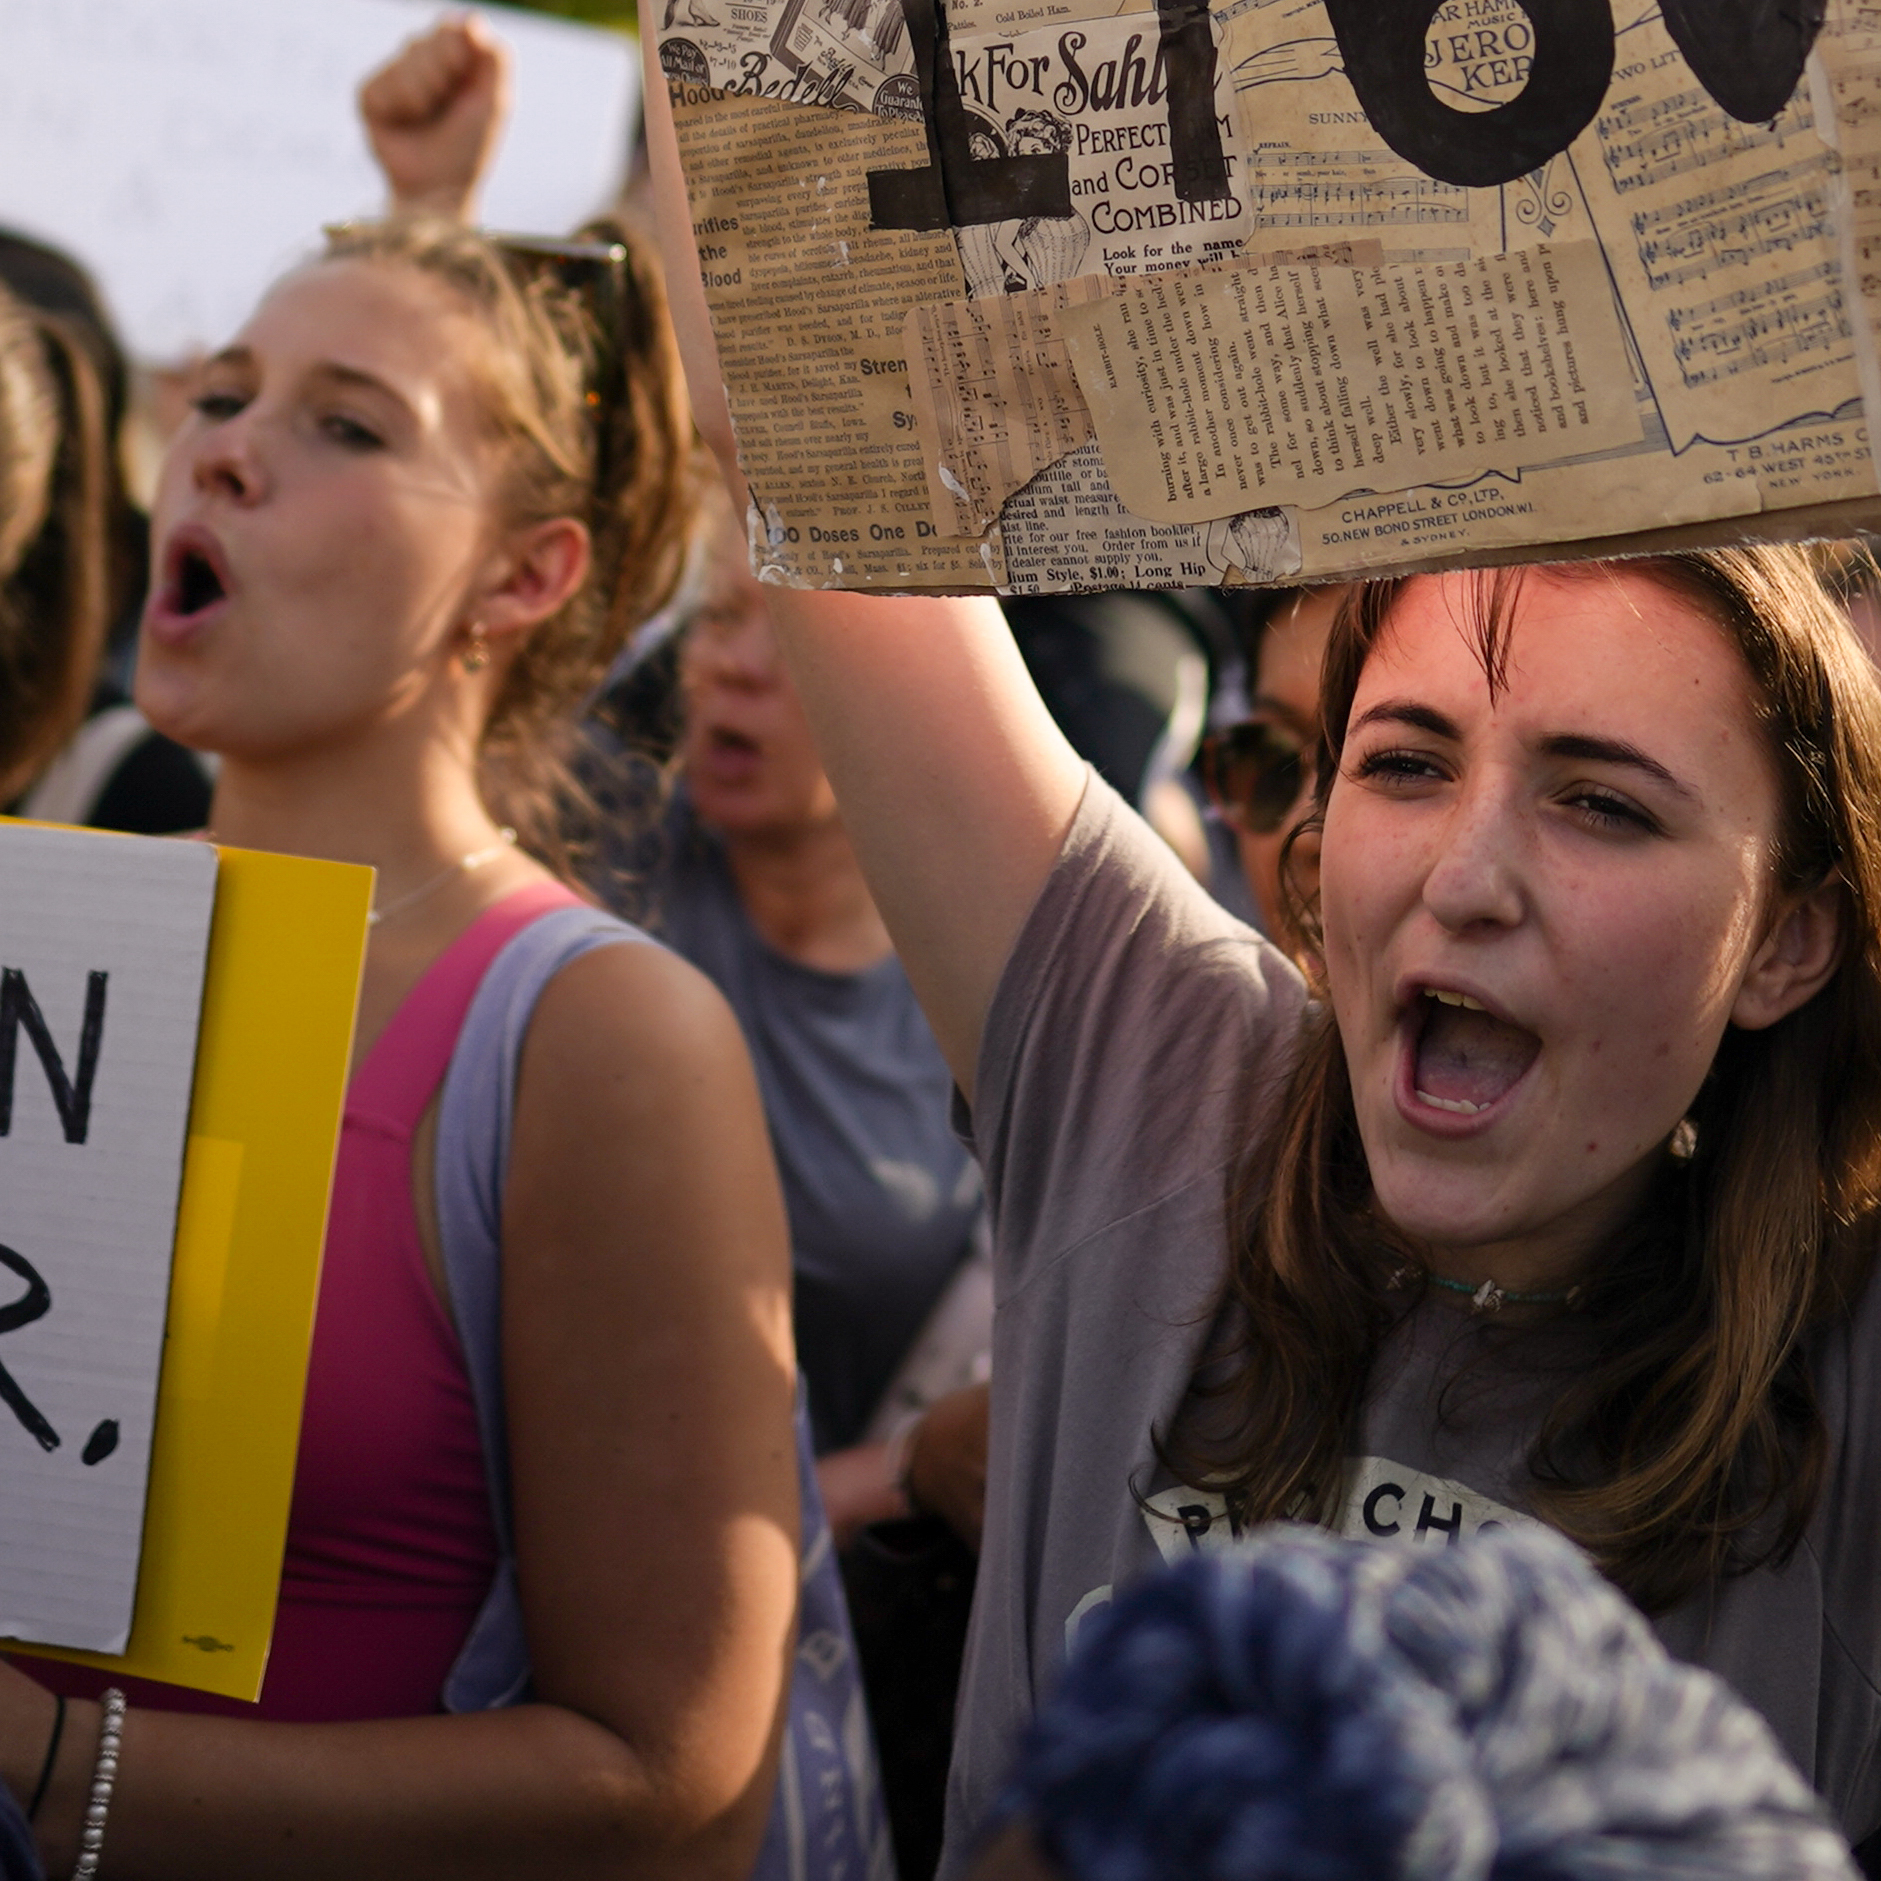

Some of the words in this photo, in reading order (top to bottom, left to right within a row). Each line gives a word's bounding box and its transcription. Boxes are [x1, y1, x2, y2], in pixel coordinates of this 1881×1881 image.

[731, 8, 768, 22] SHOES
[996, 12, 1016, 24] Cold
[1018, 9, 1044, 20] Boiled
[897, 82, 914, 96] We
[983, 42, 1050, 114] For
[1076, 122, 1168, 156] PERFECT
[1072, 171, 1110, 196] and
[1091, 196, 1242, 235] COMBINED
[1102, 247, 1136, 262] Look
[1144, 245, 1163, 258] for
[1171, 242, 1192, 255] the
[1203, 237, 1244, 250] name
[1104, 262, 1137, 276] Your
[1208, 337, 1230, 411] considering
[1563, 341, 1586, 392] pictures
[1136, 355, 1157, 413] curiosity,
[1772, 433, 1844, 455] HARMS
[1160, 452, 1177, 502] burning
[1761, 458, 1805, 473] WEST
[1341, 496, 1426, 524] CHAPPELL
[1431, 496, 1442, 509] &
[810, 526, 860, 543] Doses
[870, 523, 906, 541] One
[1076, 529, 1098, 540] free
[1104, 527, 1147, 540] fashion
[1151, 524, 1200, 537] booklet,
[1374, 519, 1411, 537] BOND
[1413, 512, 1458, 531] STREET
[1413, 529, 1470, 546] SYDNEY.
[1012, 556, 1046, 568] dealer
[1050, 554, 1089, 565] cannot
[1095, 552, 1131, 565] supply
[1136, 552, 1163, 562] you.
[1046, 565, 1084, 582] Style,
[1089, 566, 1126, 580] $1.00;
[1135, 564, 1172, 578] Long
[1180, 562, 1206, 576] Hip
